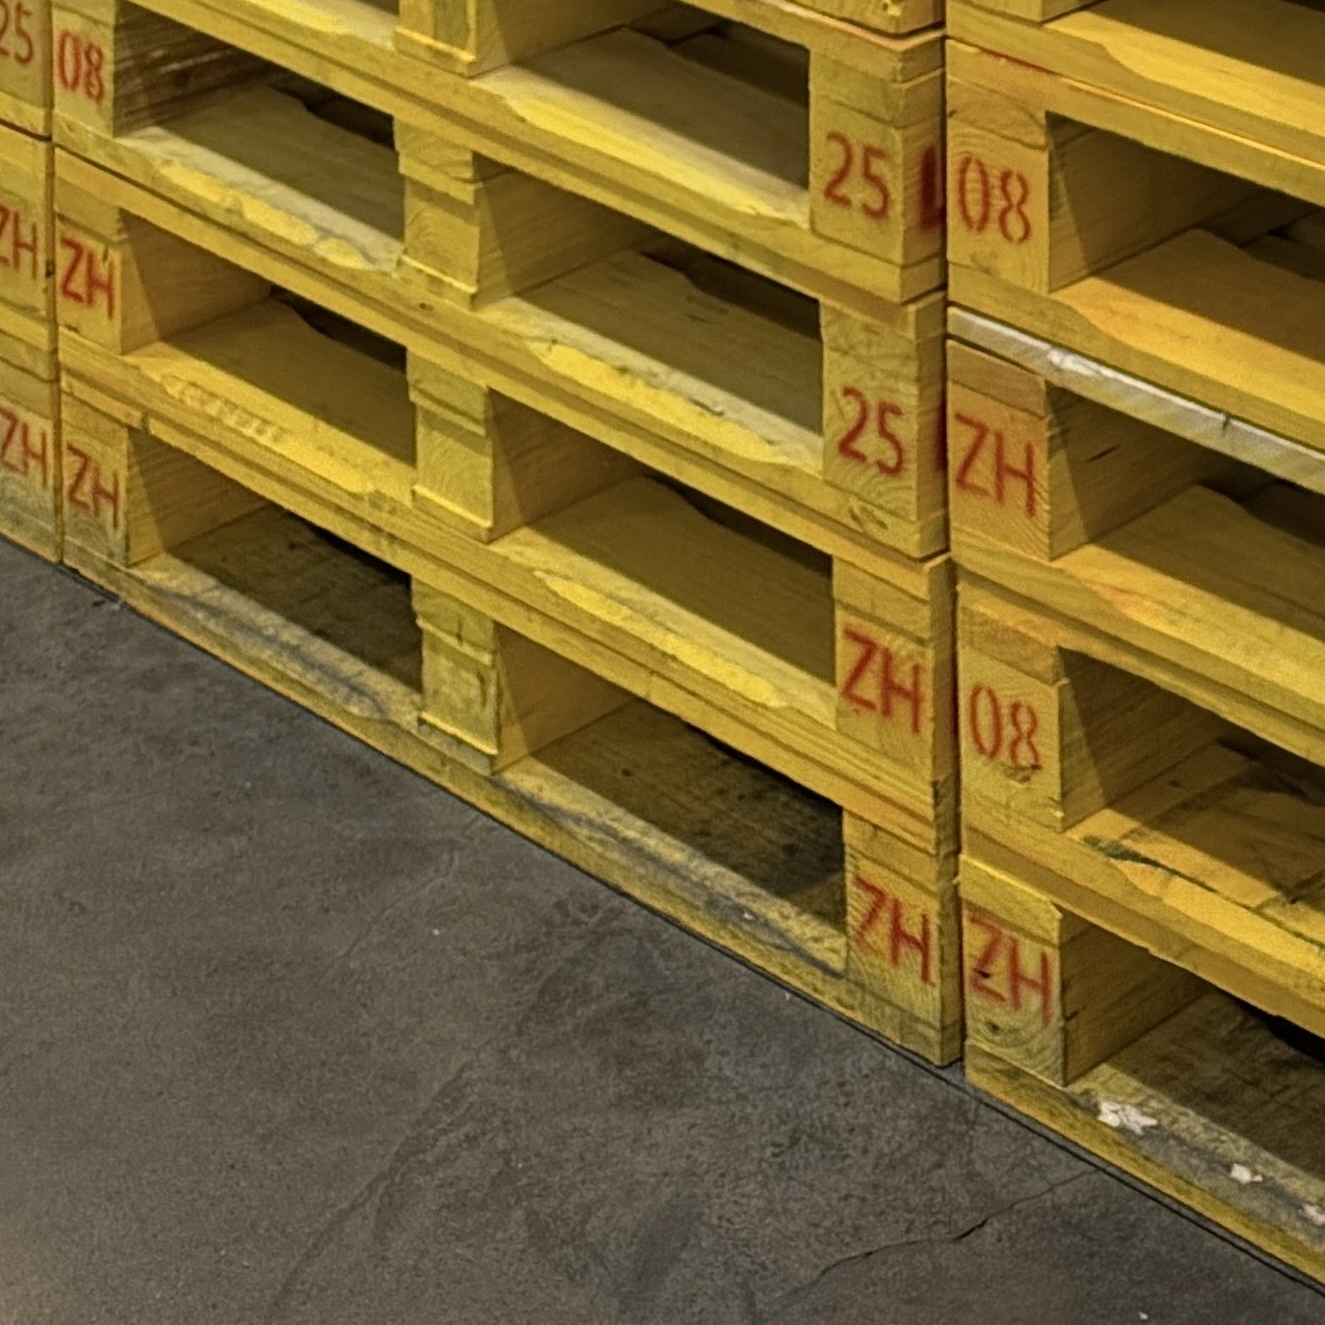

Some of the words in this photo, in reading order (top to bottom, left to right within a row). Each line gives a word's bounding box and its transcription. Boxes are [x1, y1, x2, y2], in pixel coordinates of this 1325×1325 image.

[57, 30, 104, 103] 08
[823, 130, 890, 220] 25
[958, 155, 1031, 244] 08
[60, 234, 115, 321] ZH
[838, 385, 903, 477] 25
[954, 412, 1036, 517] ZH
[66, 442, 119, 530] ZH
[842, 625, 922, 734] ZH
[969, 684, 1042, 771] 08
[855, 875, 932, 983] ZH
[969, 915, 1051, 1027] ZH
